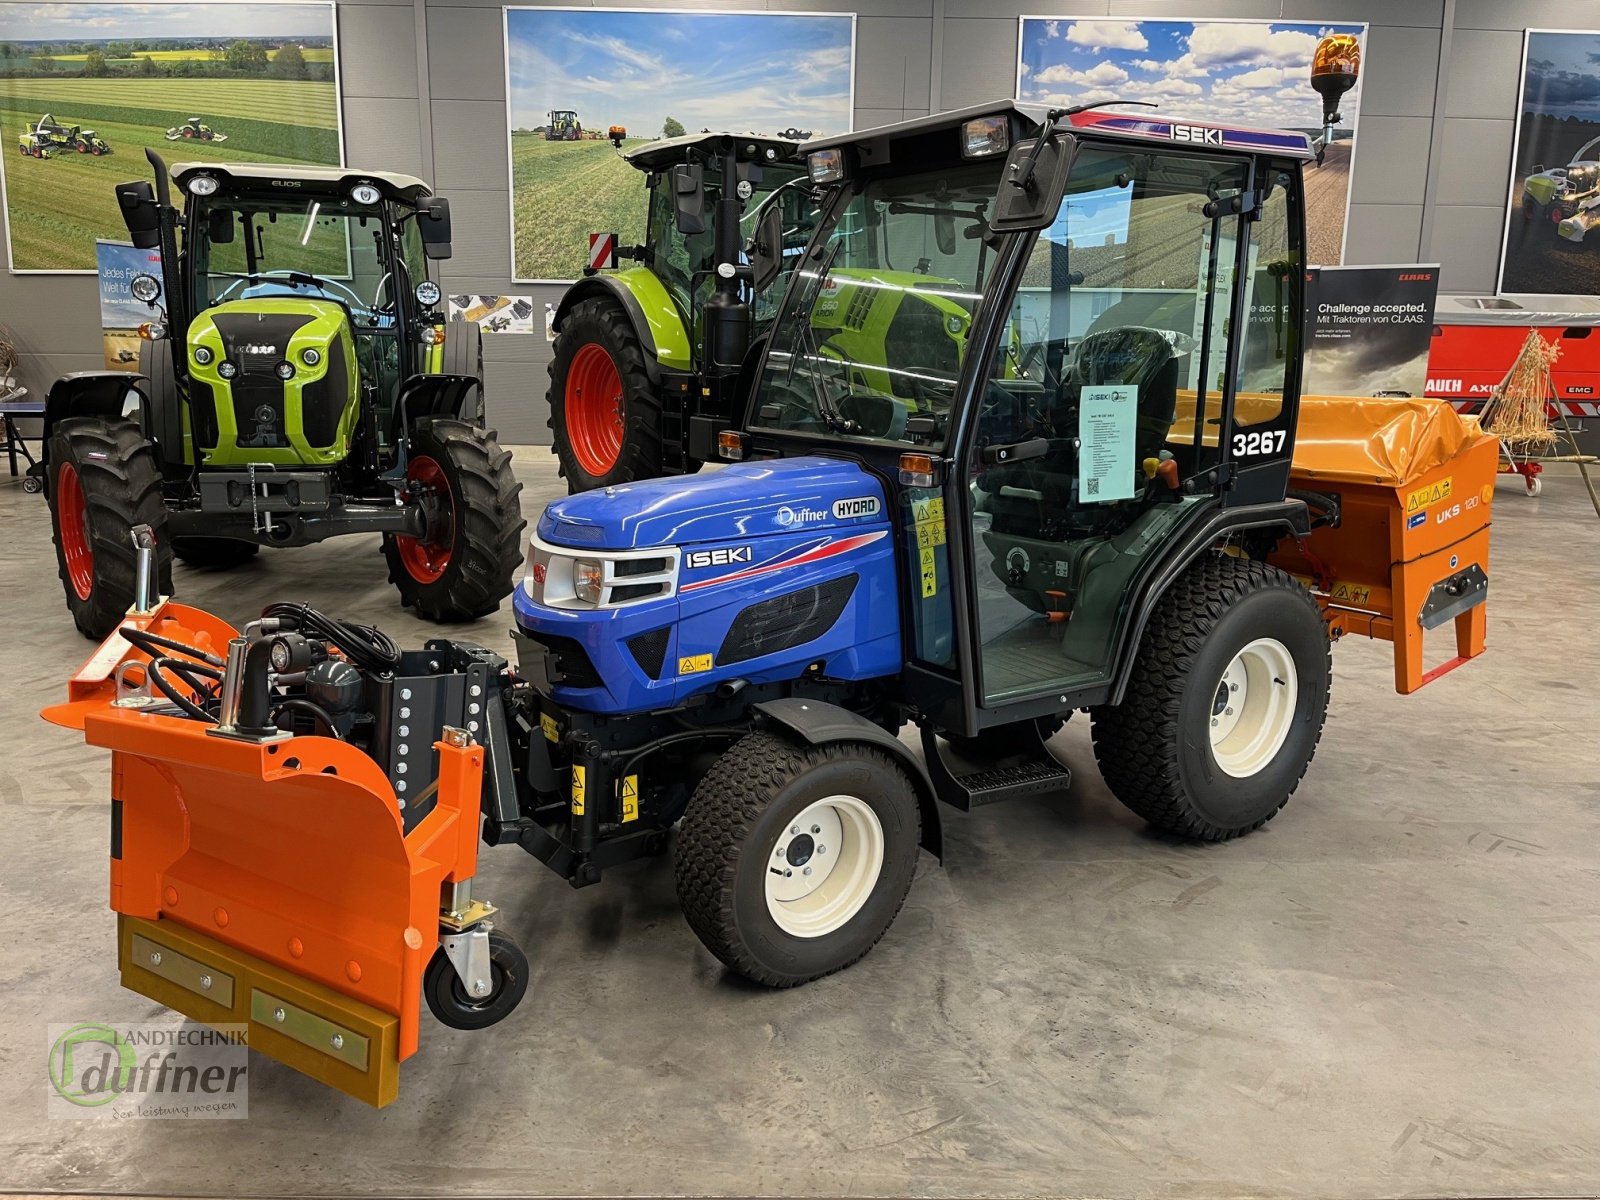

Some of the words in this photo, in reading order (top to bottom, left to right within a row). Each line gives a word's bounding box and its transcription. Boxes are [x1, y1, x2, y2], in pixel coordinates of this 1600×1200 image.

[1169, 124, 1223, 145] ISEKI
[271, 180, 302, 188] ELIOS
[103, 267, 124, 279] Jedes
[1398, 273, 1432, 281] CLAAS
[103, 281, 118, 293] Welt
[120, 282, 130, 294] für
[1318, 303, 1371, 315] Challenge
[1373, 302, 1428, 315] accepted.
[1316, 315, 1330, 324] Mit
[1332, 315, 1371, 324] Traktoren
[1373, 316, 1389, 324] von
[1391, 314, 1426, 324] CLAAS.
[1424, 379, 1462, 392] AUCH
[1232, 430, 1287, 457] 3267
[838, 500, 876, 516] HYDRO
[1465, 496, 1480, 510] 120
[777, 506, 828, 526] Duffner
[1436, 504, 1461, 524] UKS
[686, 546, 753, 569] ISEKI
